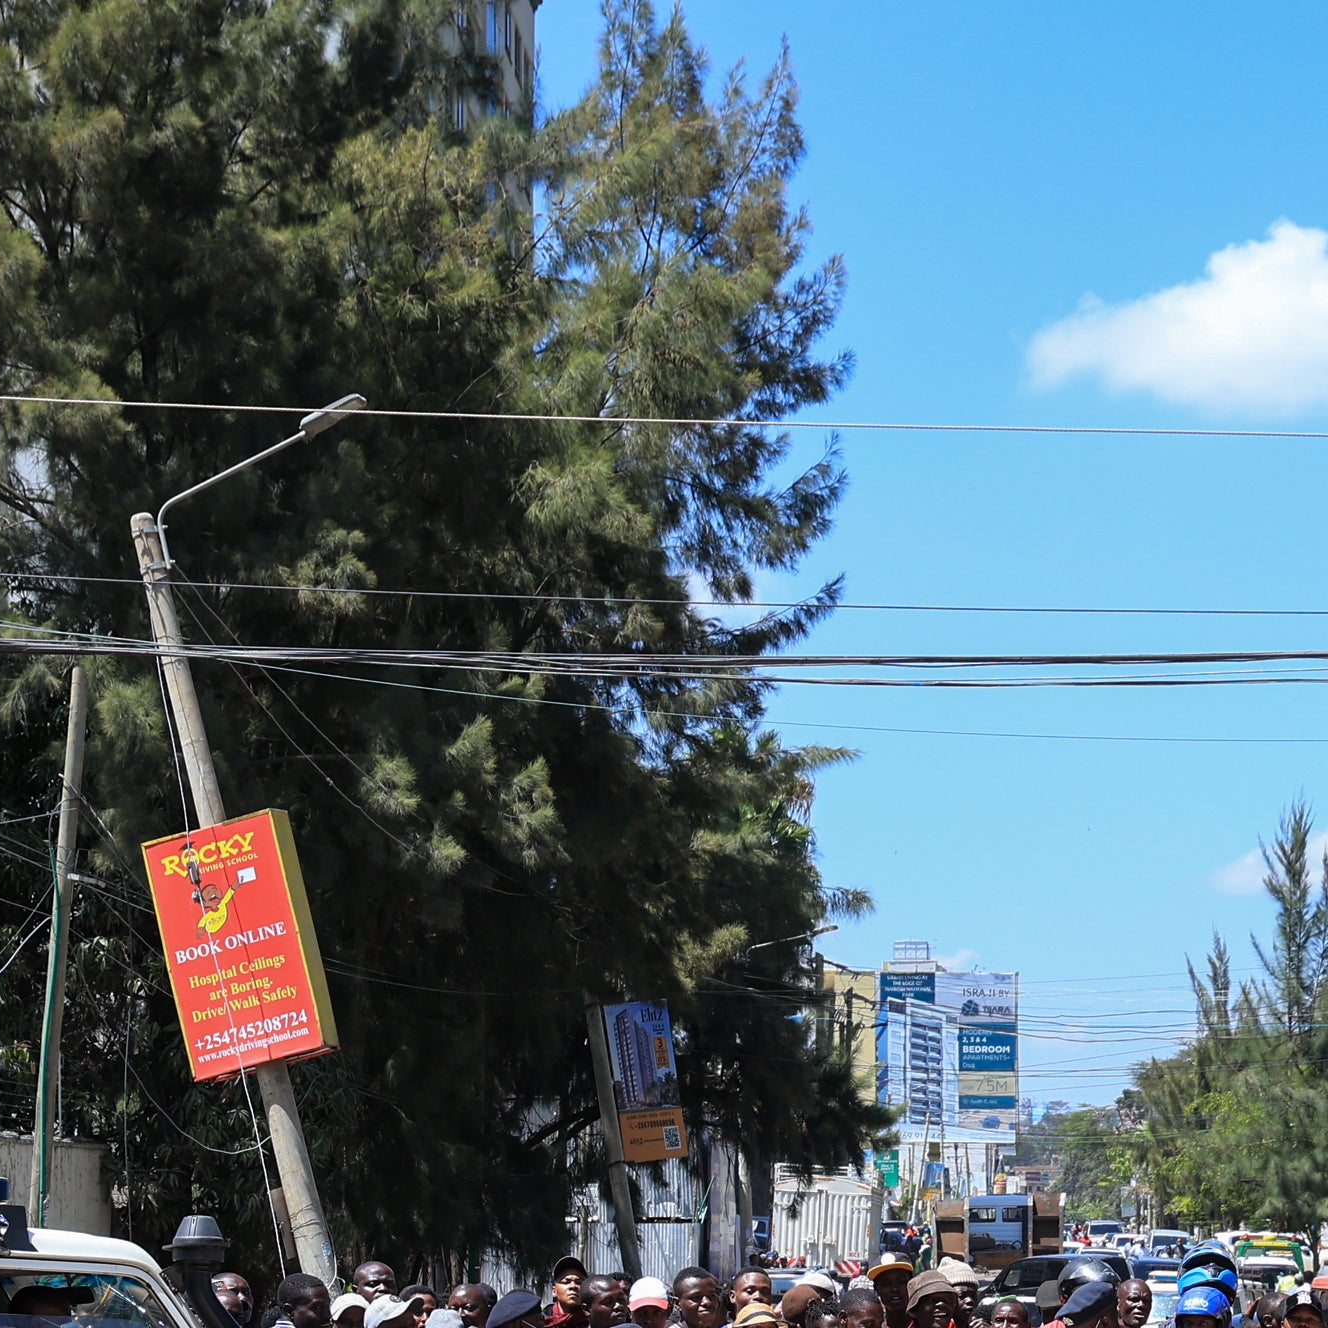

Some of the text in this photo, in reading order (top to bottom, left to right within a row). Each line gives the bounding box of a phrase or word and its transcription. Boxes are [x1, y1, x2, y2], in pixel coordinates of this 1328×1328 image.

[161, 832, 254, 878] ROCKY
[227, 852, 259, 867] SCHOOL
[175, 921, 287, 965] BOOK ONLINE
[189, 952, 286, 989] Hospital Ceilings
[209, 974, 274, 1002] are Boring.
[192, 984, 298, 1024] Drive/ Walk Safely
[999, 990, 1010, 998] BY
[195, 1008, 308, 1051] +254745208724
[197, 1025, 309, 1064] www.rockydrivingschool.com
[962, 1045, 1010, 1053] BEDROOM
[976, 1080, 1008, 1092] 7.5M
